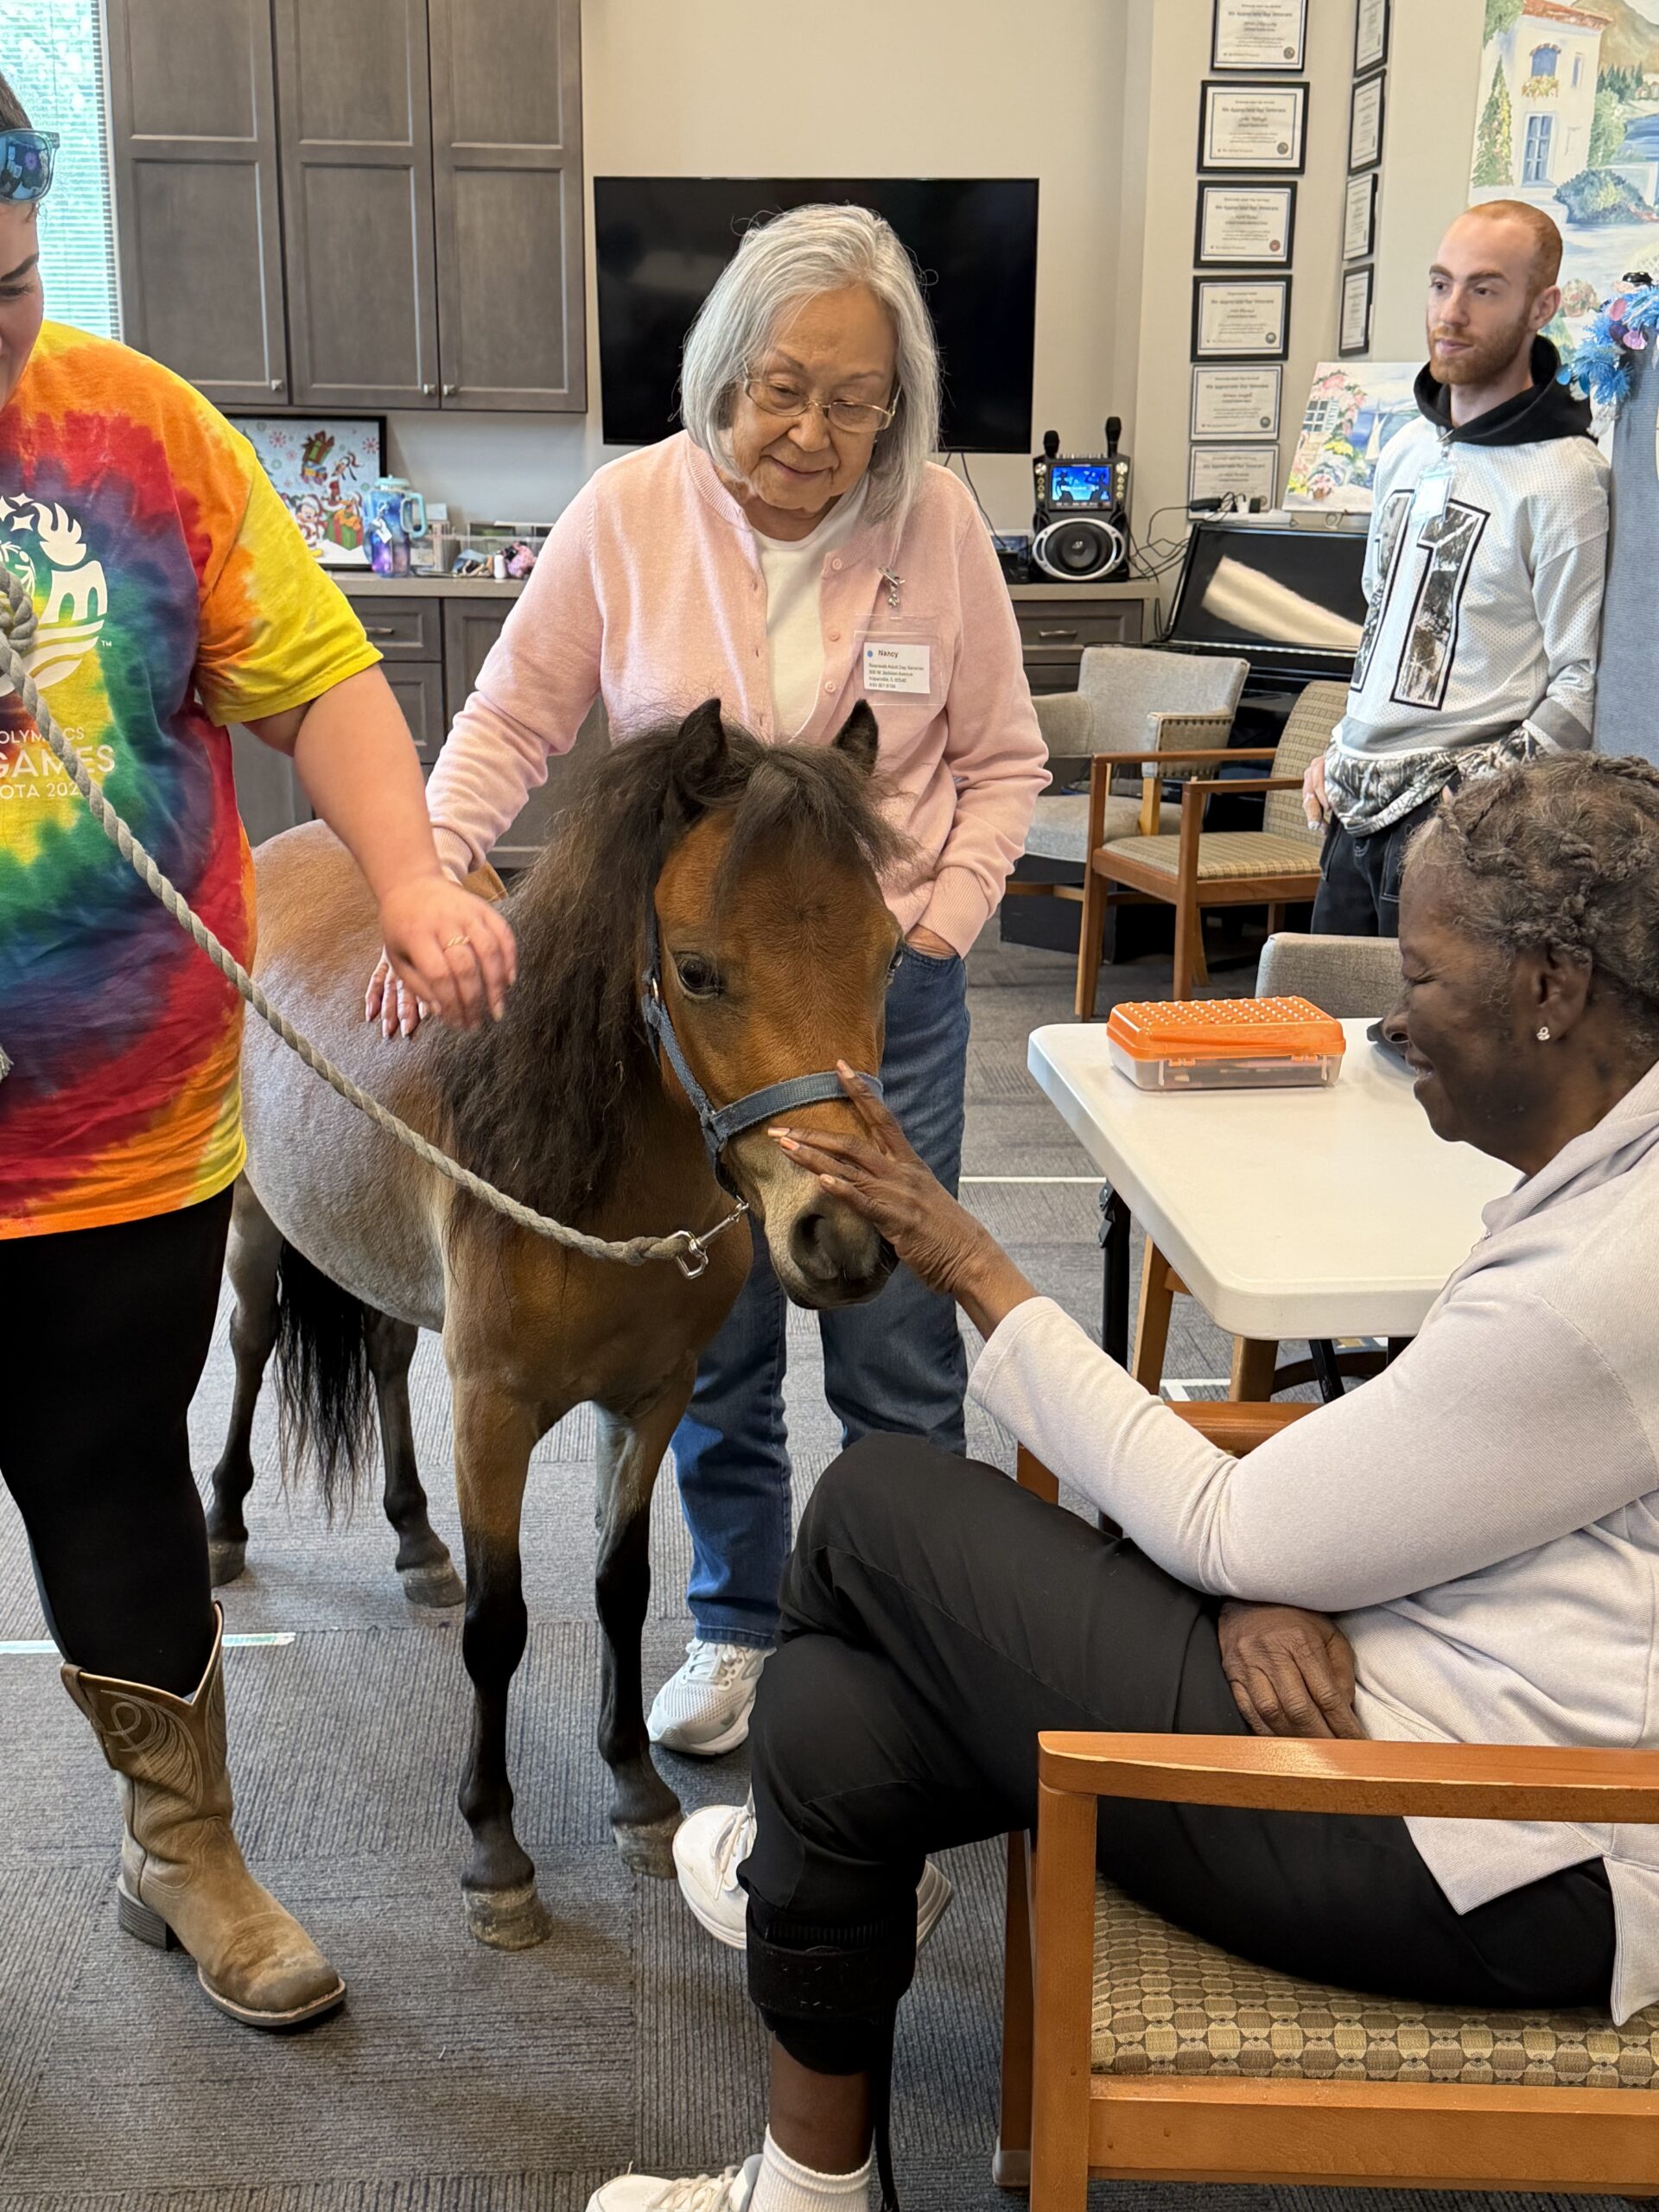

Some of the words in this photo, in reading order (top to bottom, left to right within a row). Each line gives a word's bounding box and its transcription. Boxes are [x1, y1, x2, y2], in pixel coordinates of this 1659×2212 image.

[878, 650, 899, 658] Nancy
[0, 727, 85, 744] OLYMCS
[46, 782, 81, 798] 202
